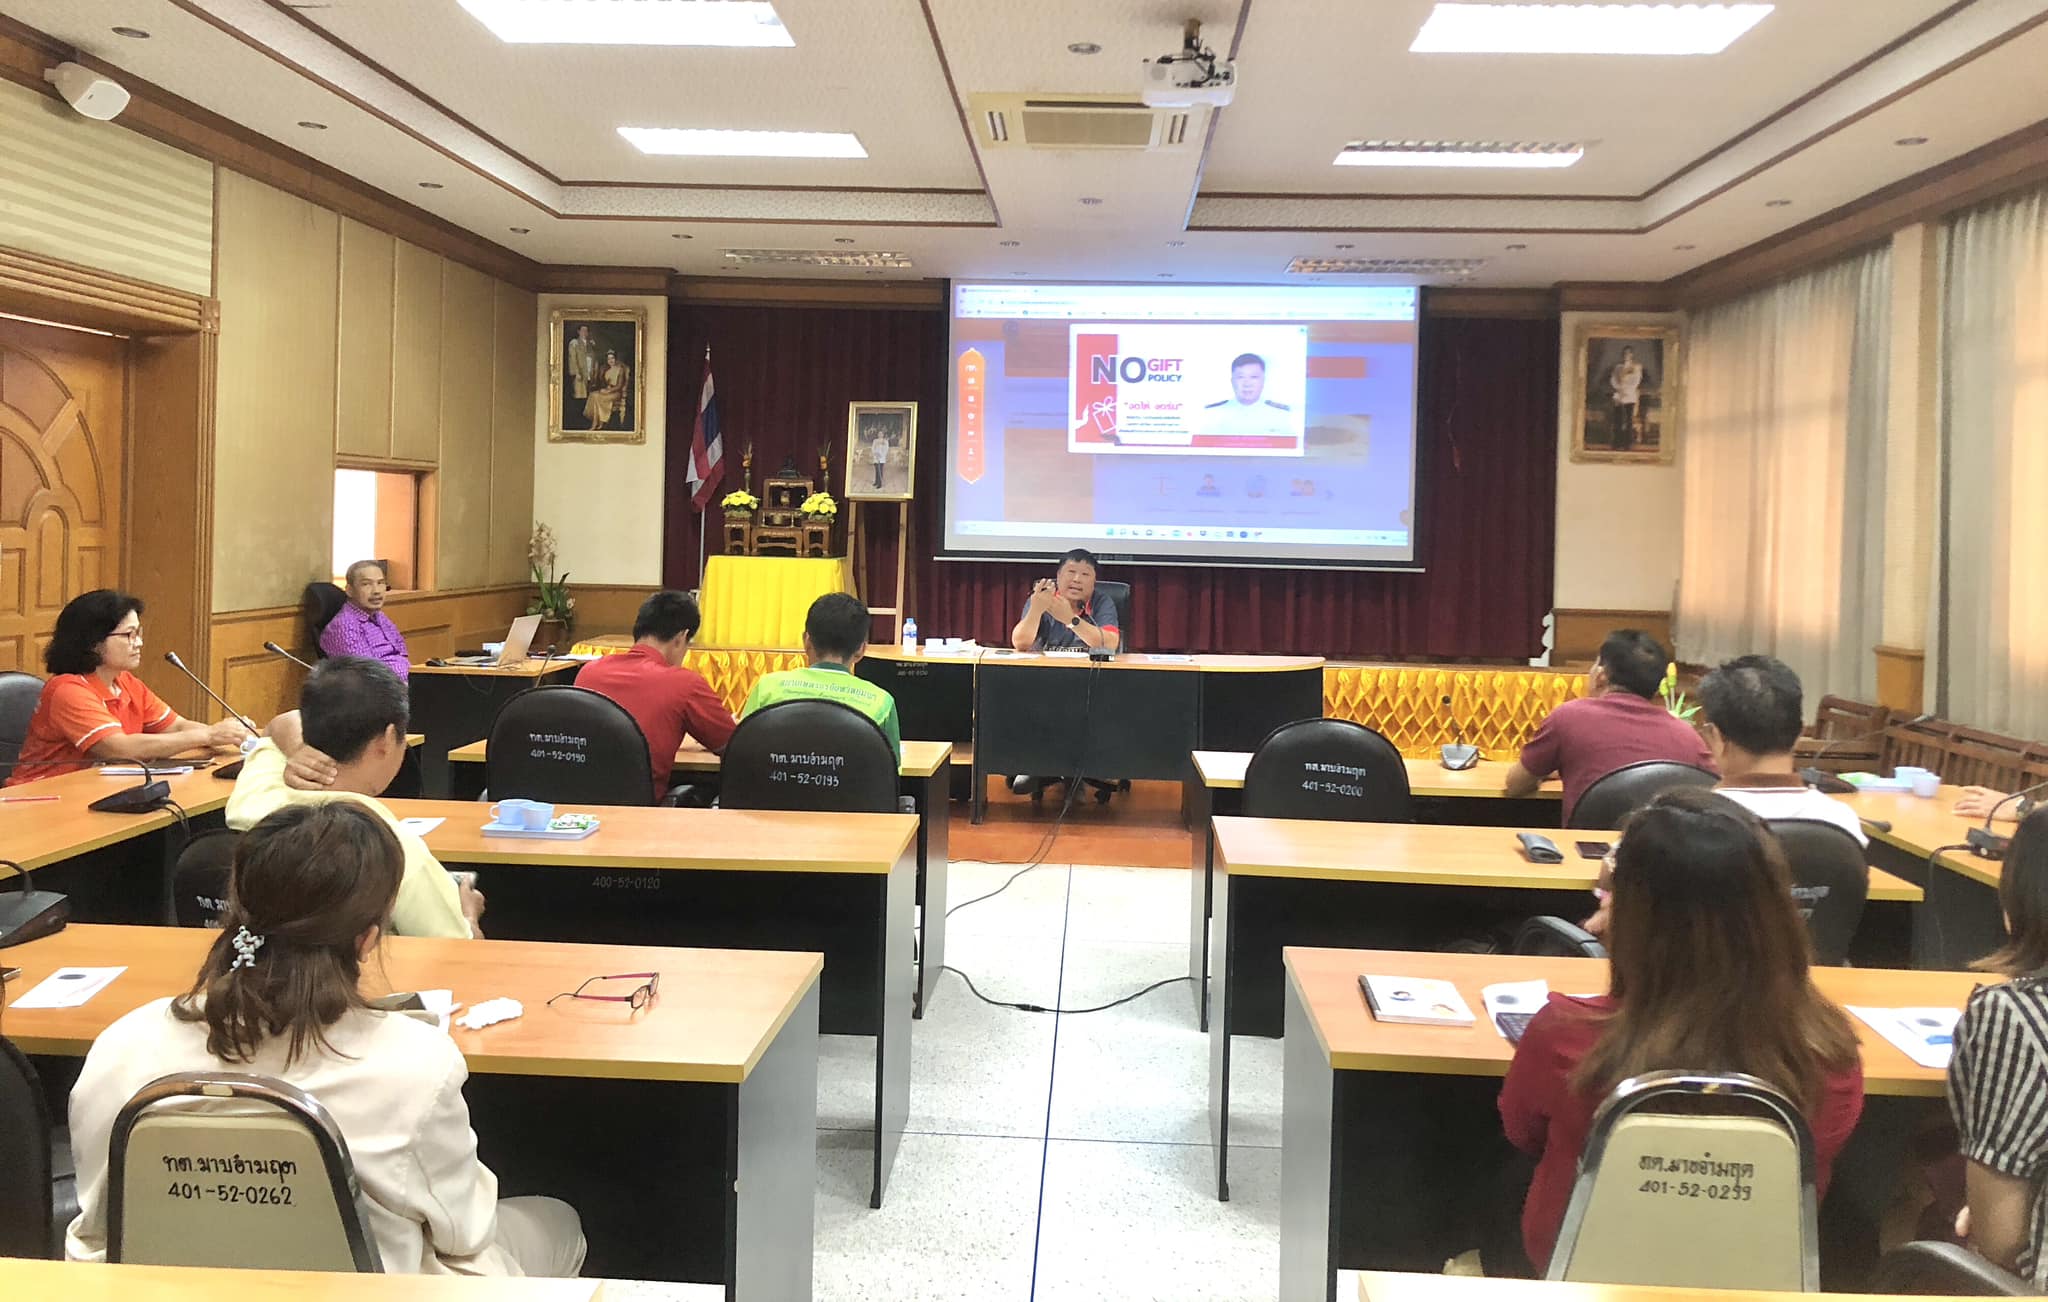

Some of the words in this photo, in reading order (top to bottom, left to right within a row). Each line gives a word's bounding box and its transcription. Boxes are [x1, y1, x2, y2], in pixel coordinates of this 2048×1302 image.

[1092, 356, 1147, 384] NO
[1147, 358, 1184, 372] GIFT
[1148, 373, 1183, 382] POLICY
[530, 749, 586, 763] 401-52-0190
[1302, 780, 1364, 797] 401-52-0200
[168, 1182, 292, 1205] 401-52-0262
[1638, 1180, 1753, 1201] 401-52-0299
